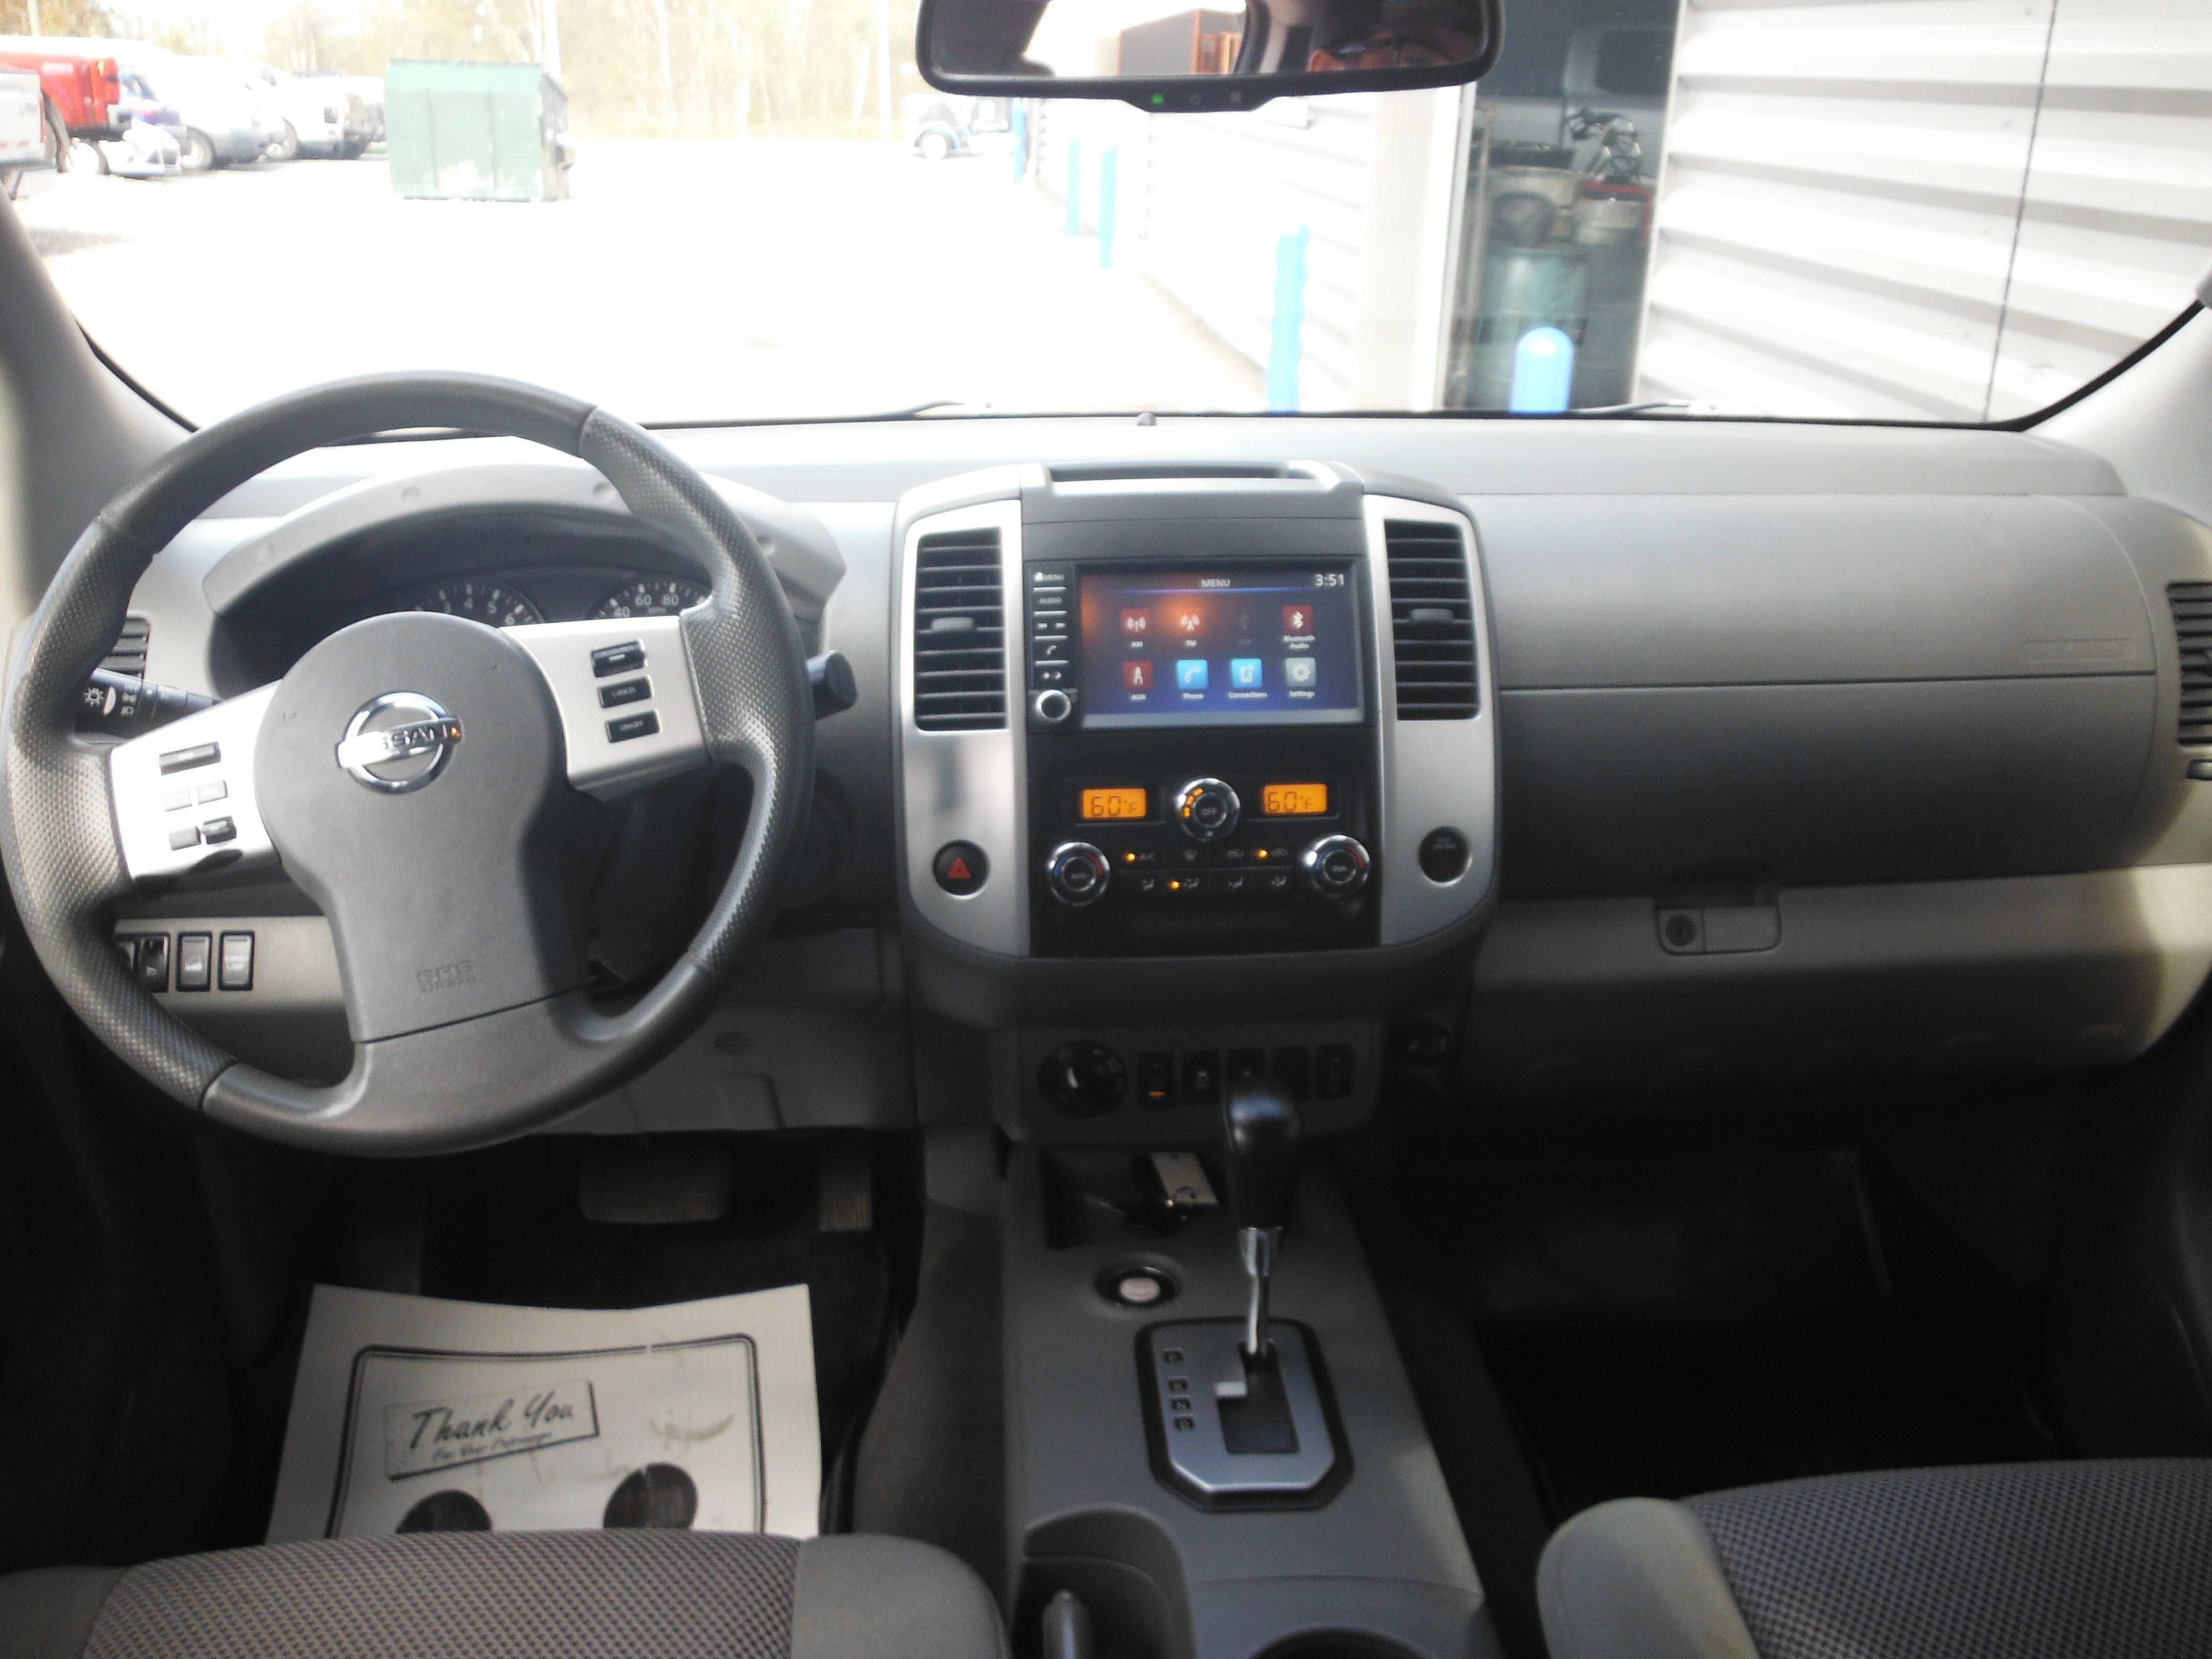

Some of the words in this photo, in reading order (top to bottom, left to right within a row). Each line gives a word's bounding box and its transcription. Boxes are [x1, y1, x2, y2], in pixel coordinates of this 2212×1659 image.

[1200, 579, 1231, 587] MENU
[1315, 573, 1344, 586] 3:51
[635, 594, 652, 606] 60
[663, 593, 679, 606] 80
[1182, 692, 1205, 700] Phone
[1228, 691, 1268, 700] Connections
[1289, 691, 1315, 699] Settings
[410, 1398, 516, 1450] Thank
[524, 1390, 575, 1428] You
